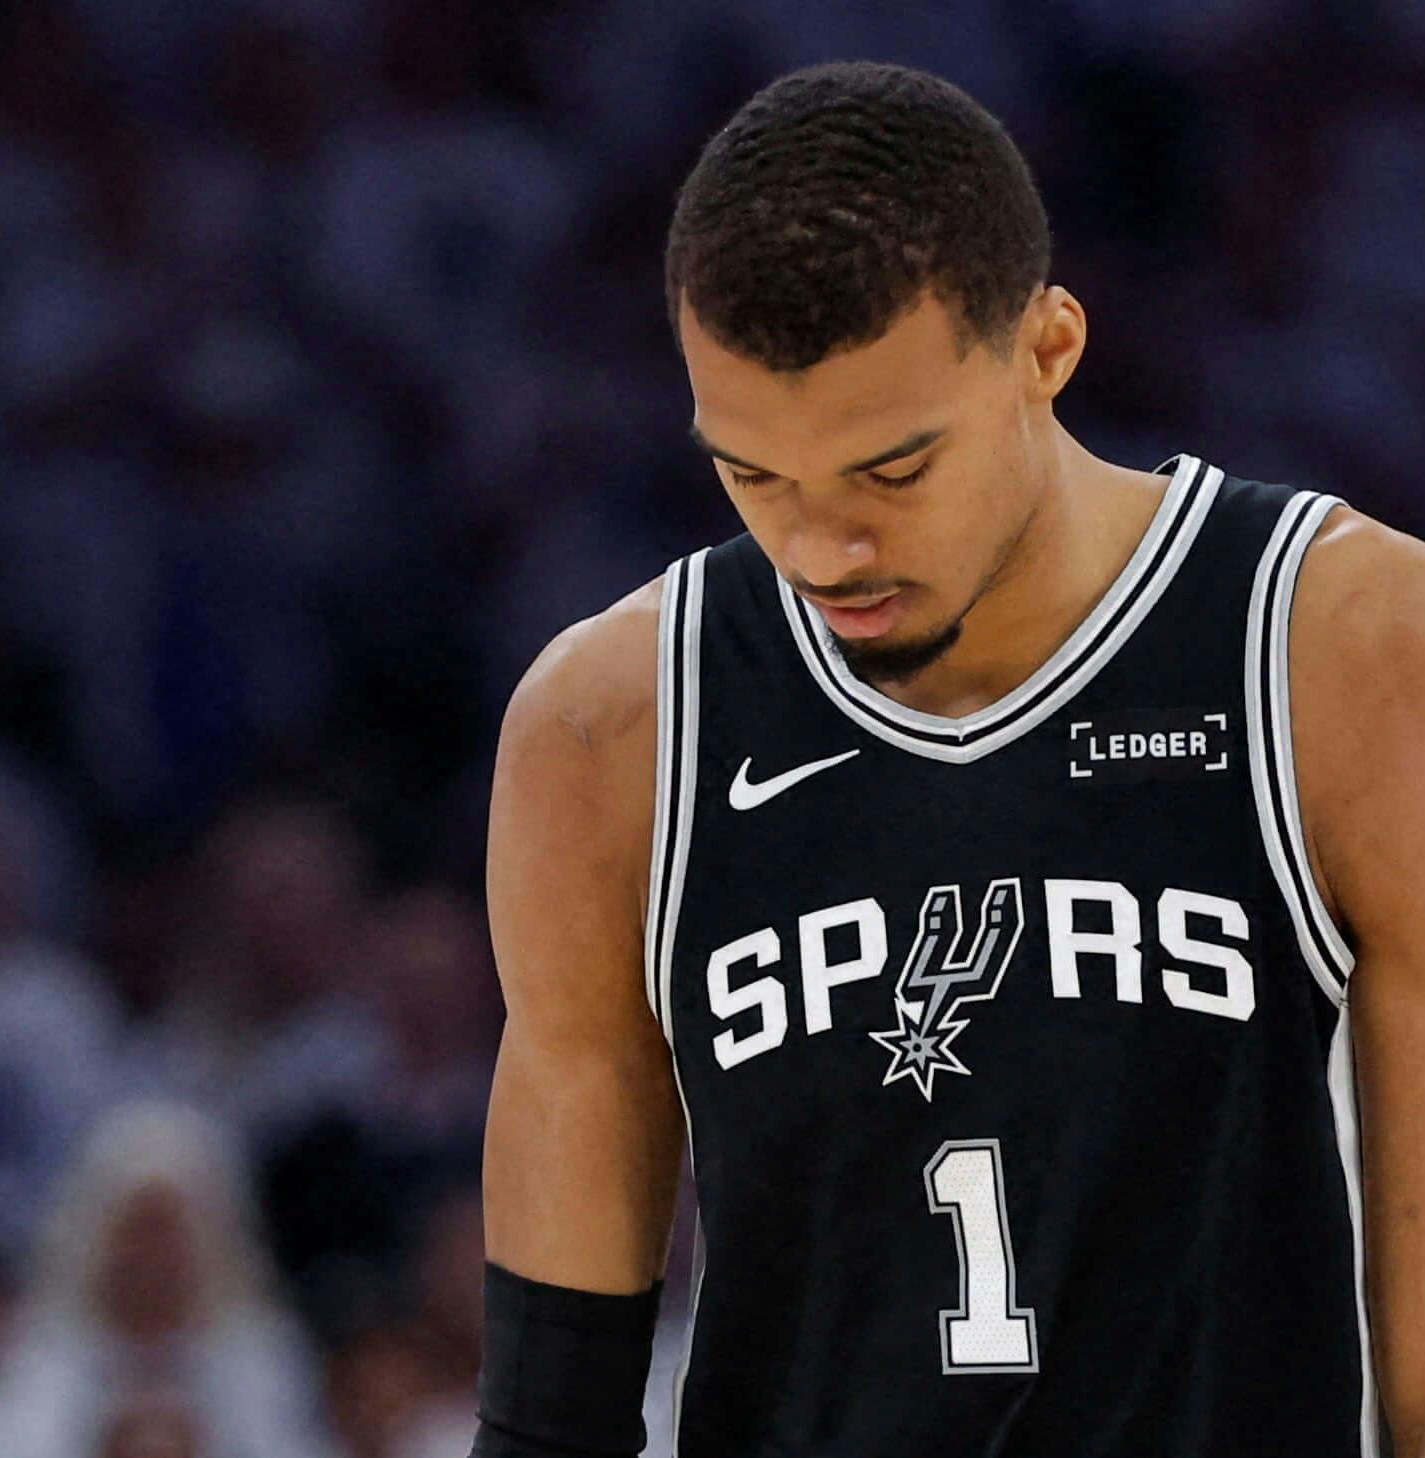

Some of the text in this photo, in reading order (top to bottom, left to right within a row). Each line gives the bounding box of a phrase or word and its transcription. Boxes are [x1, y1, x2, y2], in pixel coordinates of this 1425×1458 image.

[1089, 731, 1207, 760] LEDGER
[706, 877, 1256, 1102] SPURS
[924, 1138, 1039, 1374] 1
